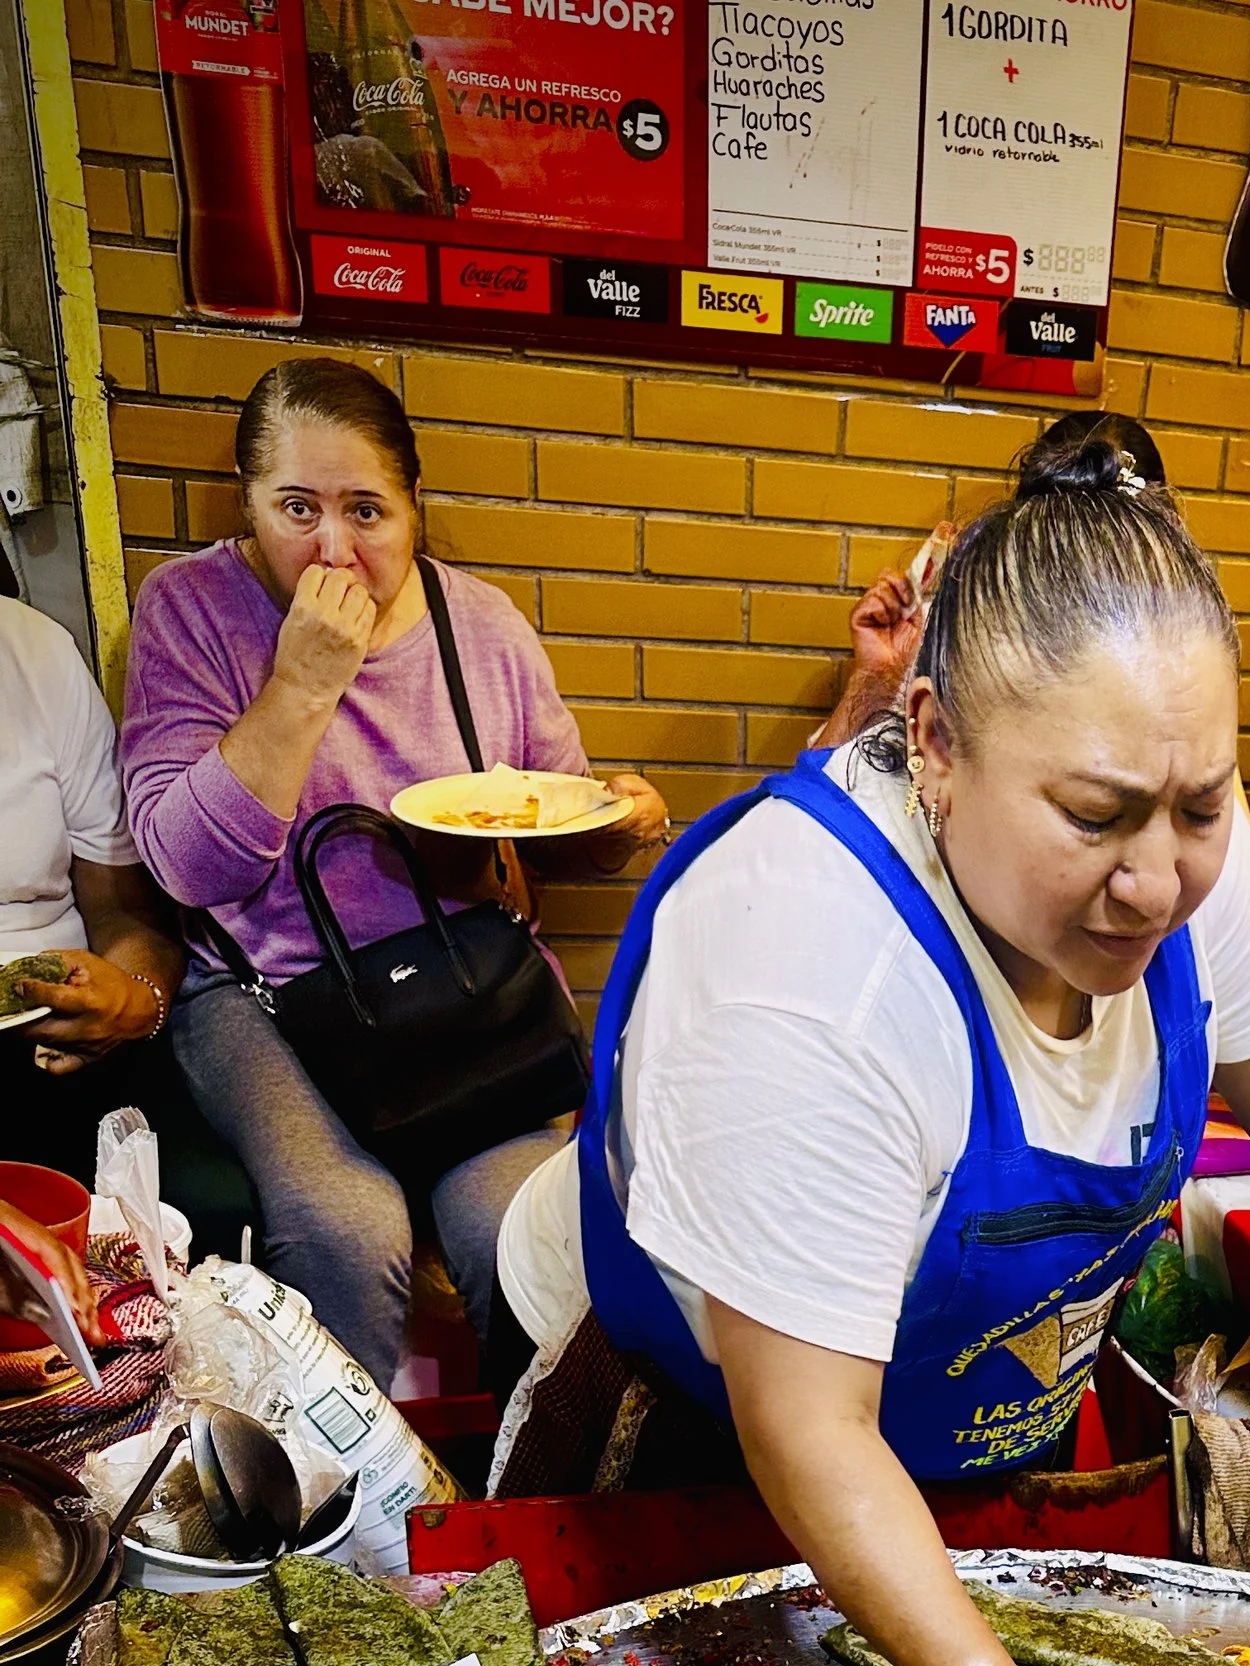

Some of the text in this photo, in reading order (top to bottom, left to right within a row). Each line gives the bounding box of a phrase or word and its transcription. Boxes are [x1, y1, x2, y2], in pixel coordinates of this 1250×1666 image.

[185, 14, 249, 36] MUNDET
[523, 0, 675, 36] MEJOR?
[708, 2, 844, 49] Tlacoyos
[959, 5, 1068, 47] GORDITA
[712, 37, 824, 75] Gorditas
[353, 77, 424, 111] Coca-Cola
[447, 69, 621, 103] AGREGA UN REFRESCO
[714, 70, 825, 103] Huaraches
[448, 88, 613, 133] Y AHORRA
[711, 100, 811, 137] Flautas
[622, 112, 663, 151] $5
[937, 111, 948, 138] 1
[955, 113, 1006, 141] COCA
[1014, 120, 1066, 144] COLA
[712, 132, 767, 160] Cafe
[945, 144, 984, 157] vidrio
[347, 245, 391, 258] ORIGINAL
[925, 252, 966, 265] REFRESCO
[955, 246, 972, 255] CON
[333, 262, 406, 293] Coca-Cola
[460, 261, 530, 292] Coca-Cola
[600, 269, 615, 281] del
[923, 264, 973, 279] AHORRA
[975, 248, 1010, 284] $5
[587, 278, 640, 302] Valle
[698, 283, 761, 314] FRESCA
[1020, 285, 1044, 294] ANTES
[615, 305, 641, 318] FIZZ
[809, 299, 874, 328] Sprite
[1041, 312, 1056, 323] del
[1029, 320, 1077, 343] Valle
[946, 1287, 1064, 1377] QUESADILLAS
[953, 1412, 1043, 1443] TENEMOS
[974, 1401, 1021, 1424] LAS
[988, 1434, 1019, 1454] DE
[382, 1504, 395, 1515] EN
